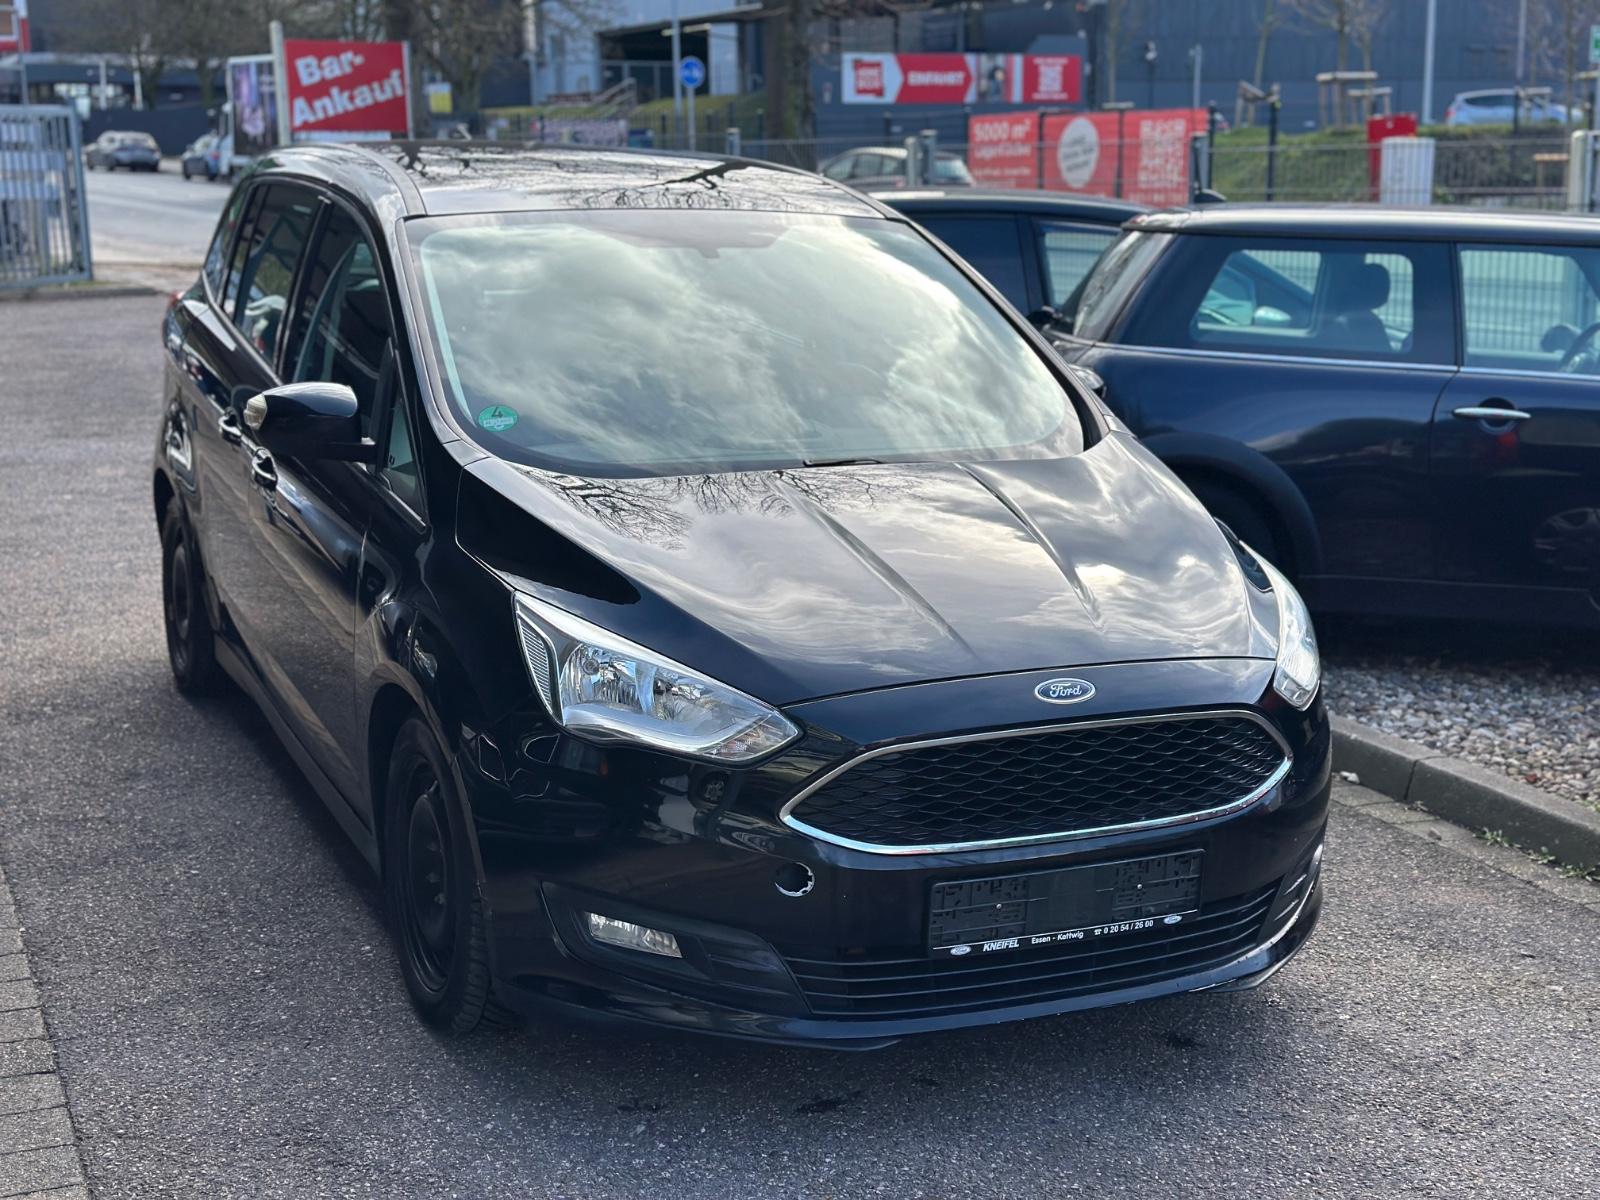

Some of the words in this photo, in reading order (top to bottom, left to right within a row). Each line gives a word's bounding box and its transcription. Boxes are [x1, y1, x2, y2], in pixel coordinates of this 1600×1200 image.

[295, 51, 364, 87] Bar-
[293, 69, 403, 128] Ankauf
[491, 406, 503, 418] 4
[1050, 682, 1082, 697] Ford
[1109, 925, 1119, 933] 20
[1120, 923, 1129, 932] 54
[1134, 921, 1144, 930] 26
[1145, 919, 1154, 928] 00
[983, 939, 1019, 952] KNEIFEL
[1031, 936, 1051, 945] Essen
